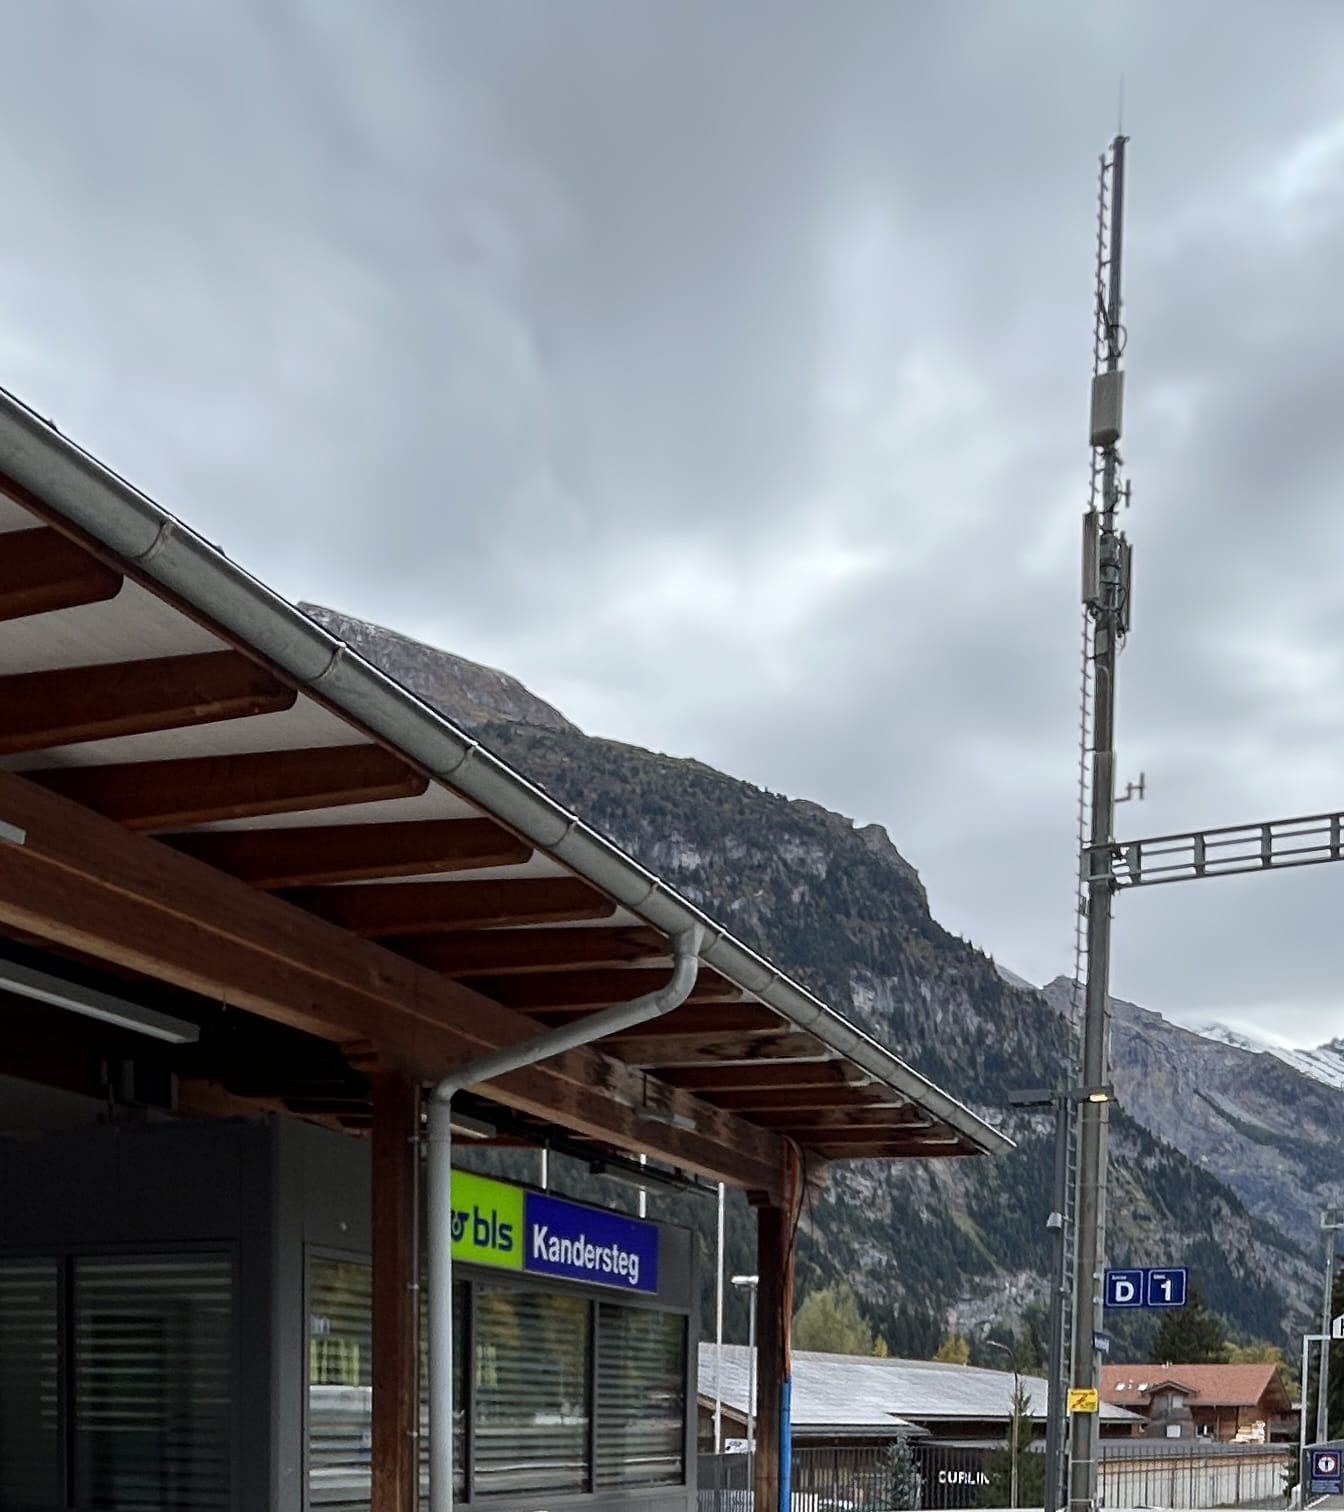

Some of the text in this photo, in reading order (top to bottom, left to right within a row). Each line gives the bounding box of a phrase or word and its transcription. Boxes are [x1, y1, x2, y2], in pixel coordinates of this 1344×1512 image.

[473, 1206, 513, 1252] bls
[533, 1224, 639, 1285] Kandersteg
[1116, 1280, 1171, 1302] D 1
